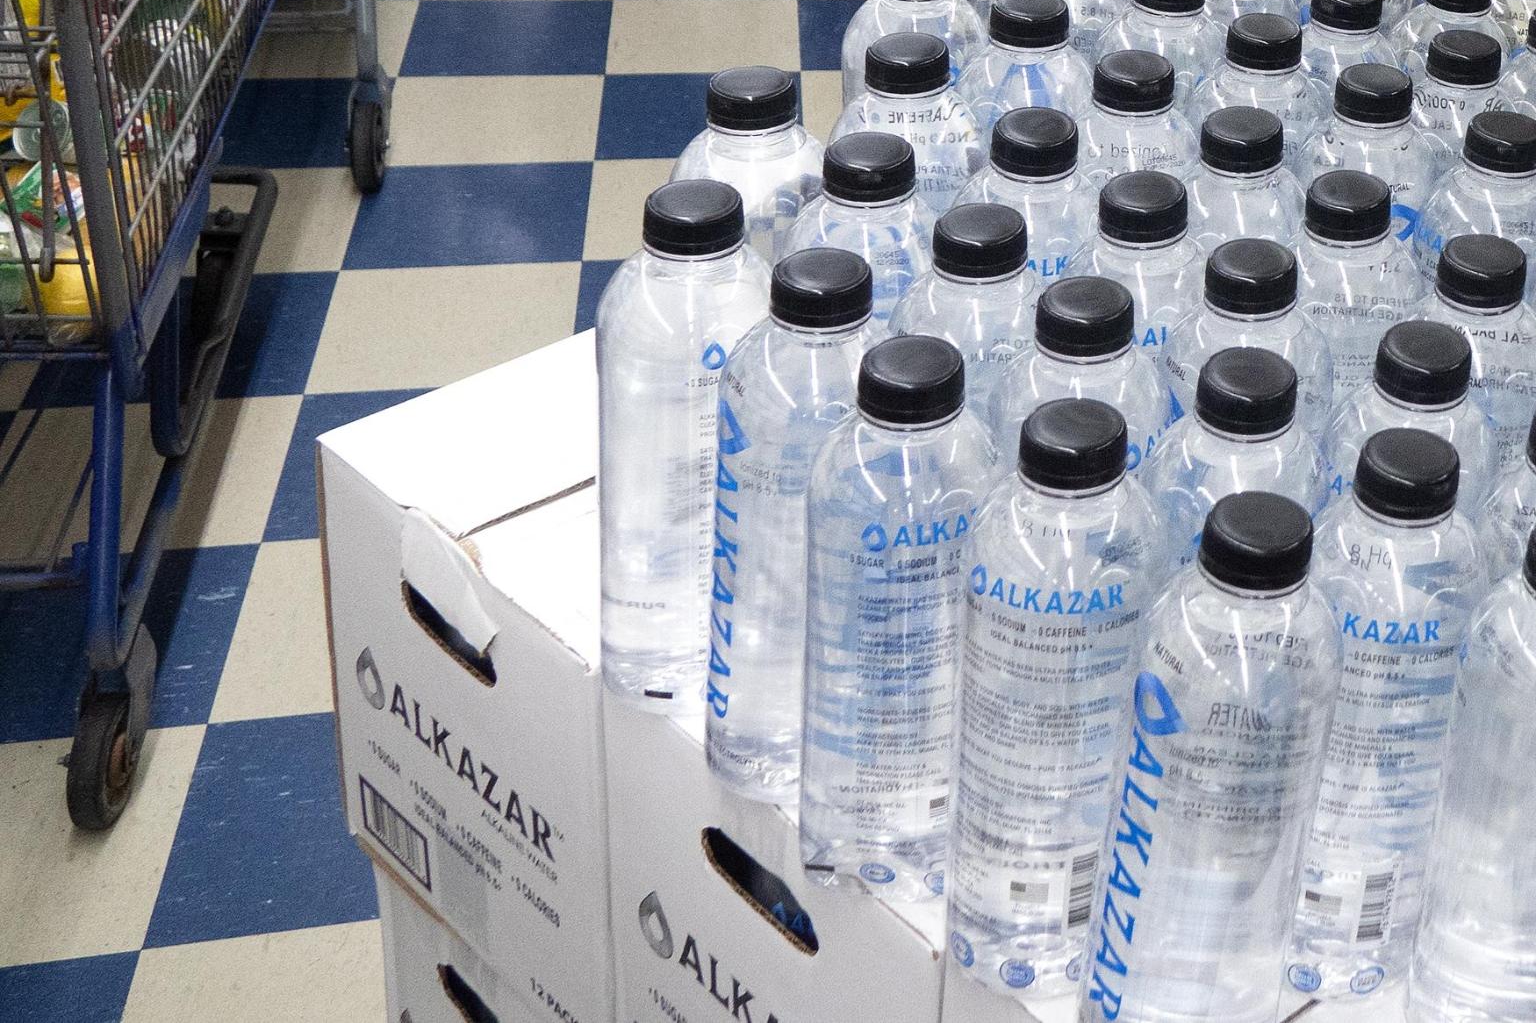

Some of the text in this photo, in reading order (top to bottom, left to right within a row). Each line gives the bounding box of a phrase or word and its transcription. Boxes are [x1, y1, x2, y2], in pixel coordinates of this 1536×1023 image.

[893, 512, 970, 548] ALKA
[857, 555, 885, 569] SUGAR
[989, 576, 1125, 615] ALKAZAR
[1045, 626, 1087, 639] CAFFEINE
[1342, 611, 1441, 645] KAZAR
[1013, 639, 1058, 654] BALANCED
[1152, 642, 1184, 675] NATURAL
[1361, 652, 1401, 666] CAFFEINE
[1344, 664, 1372, 678] ANCED
[390, 684, 555, 862] ALKAZAR
[1089, 727, 1164, 1023] ALKAZAR
[679, 934, 778, 1023] ALK
